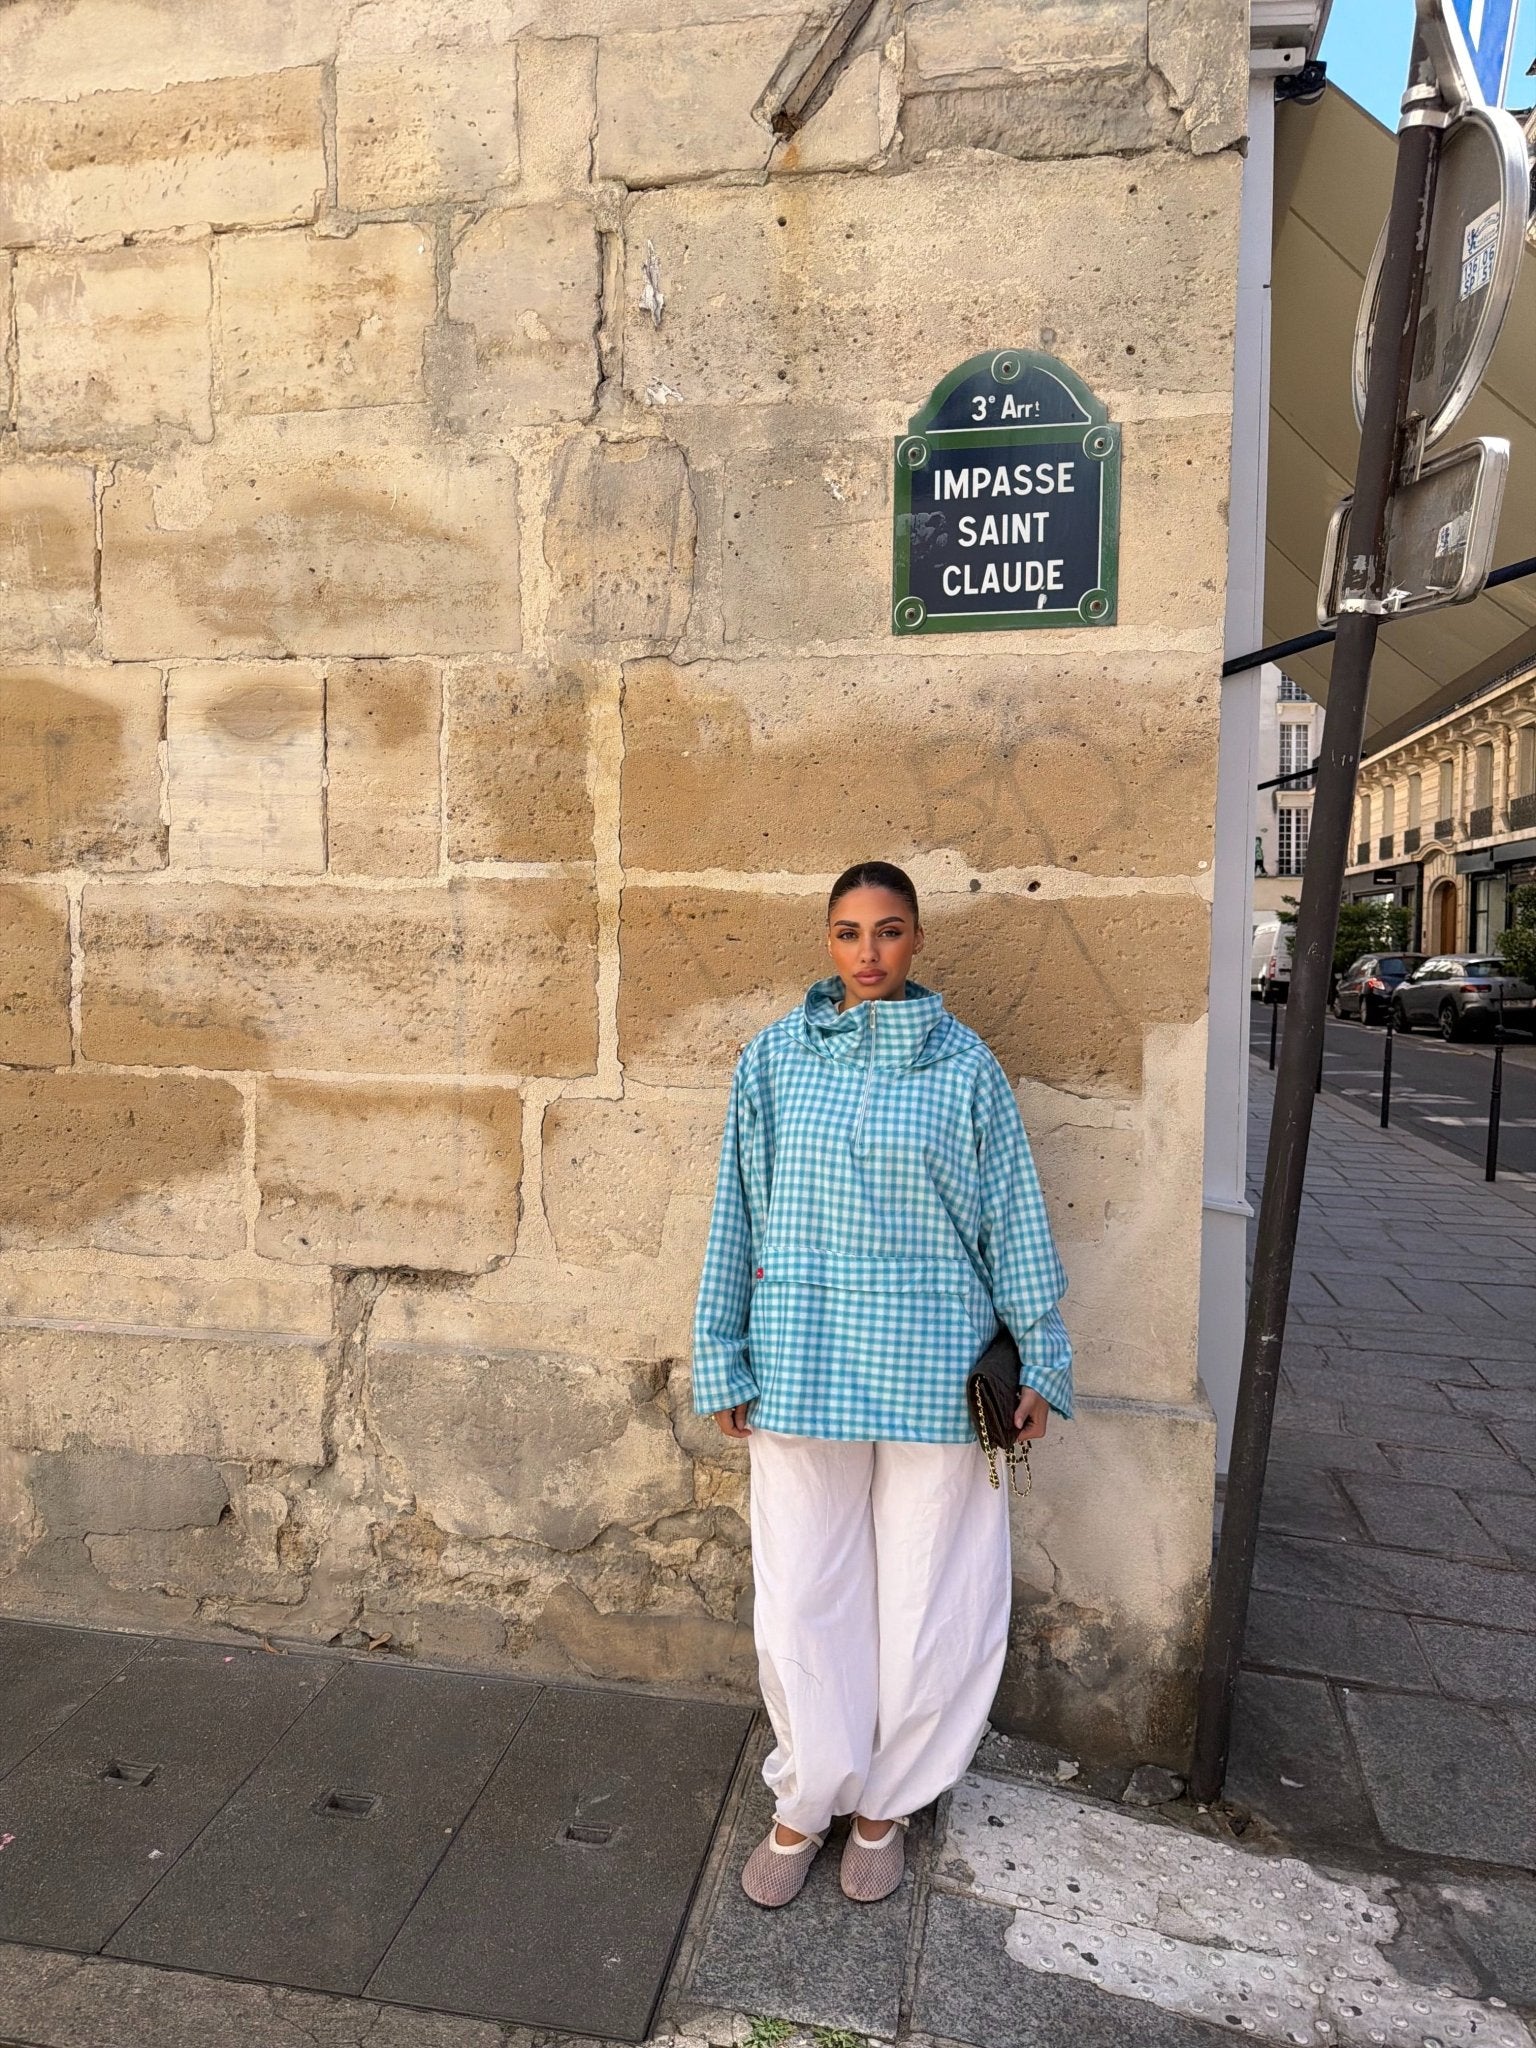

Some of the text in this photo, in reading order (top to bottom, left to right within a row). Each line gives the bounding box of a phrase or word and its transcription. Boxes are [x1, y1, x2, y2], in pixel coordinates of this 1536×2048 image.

[934, 462, 1075, 500] IMPASSE
[958, 512, 1050, 547] SAINT
[942, 559, 1064, 596] CLAUDE
